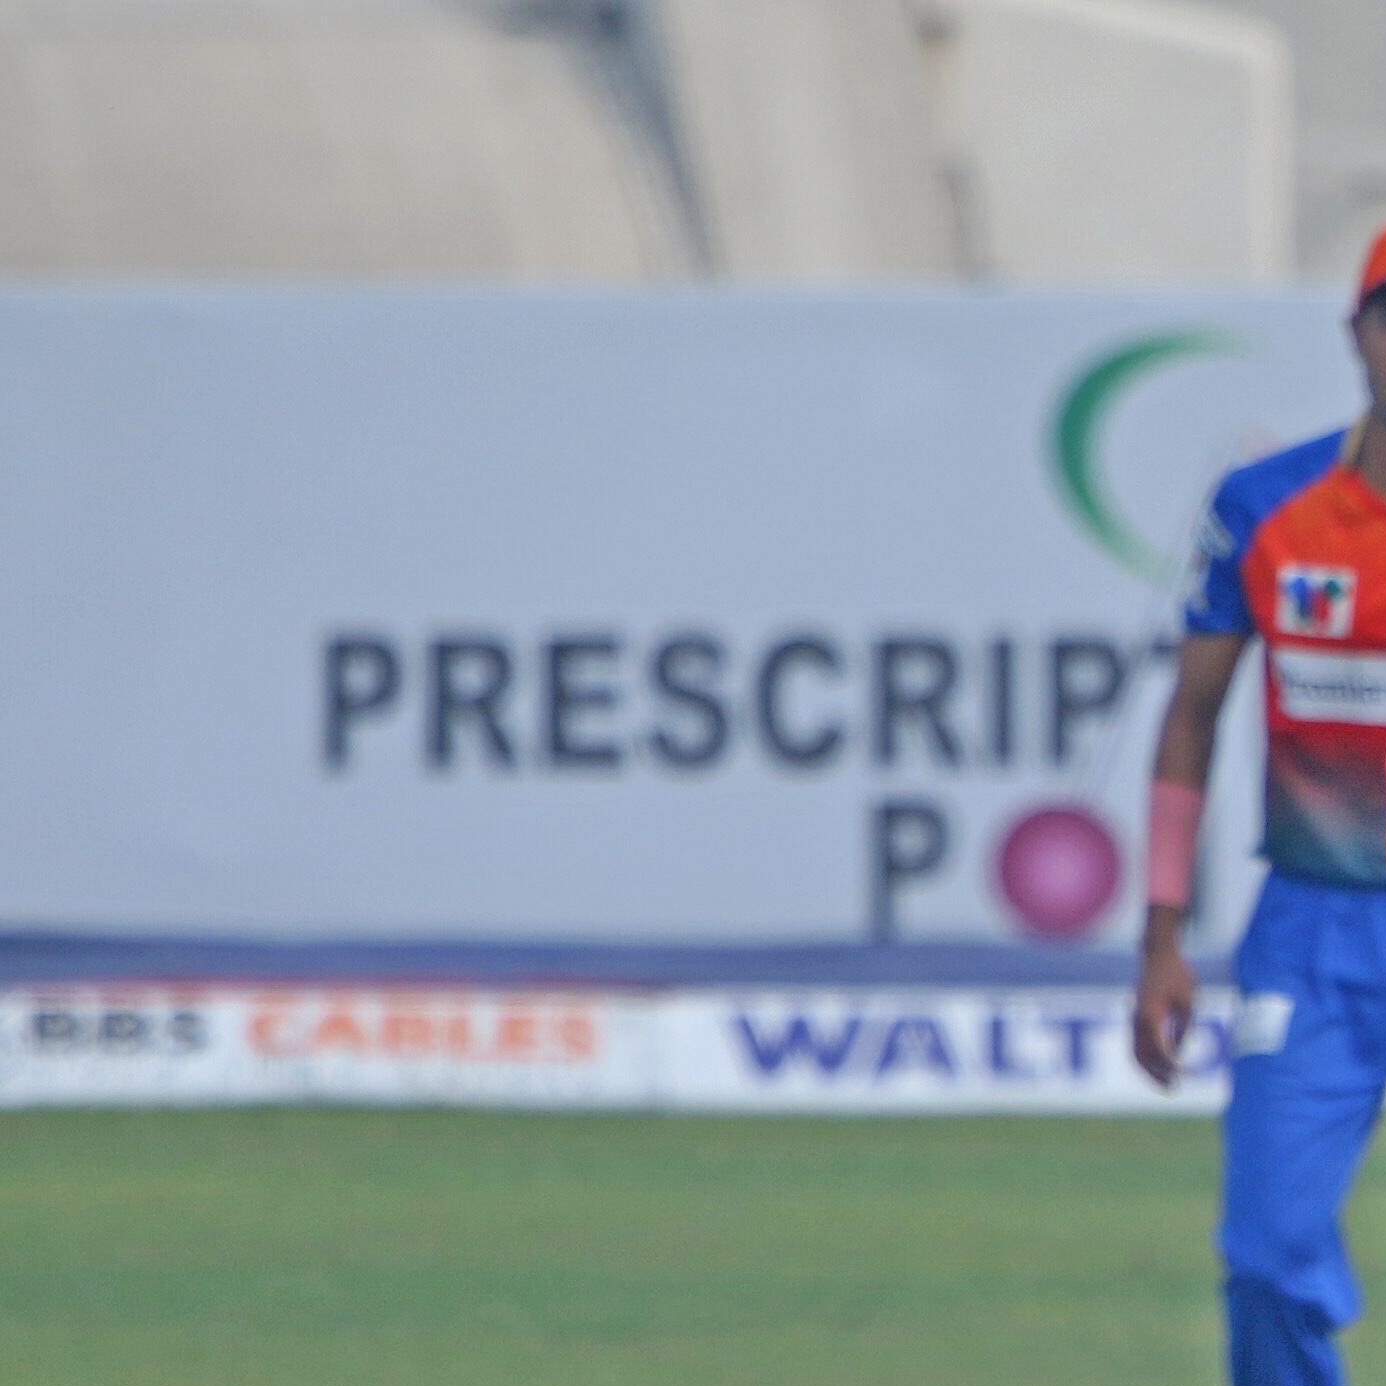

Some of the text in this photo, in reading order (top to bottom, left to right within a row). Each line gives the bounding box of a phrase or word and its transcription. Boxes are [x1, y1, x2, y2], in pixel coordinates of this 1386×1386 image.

[320, 634, 1180, 772] PRESCRIP
[246, 991, 594, 1061] CABLES
[730, 1012, 1232, 1078] WALTO
